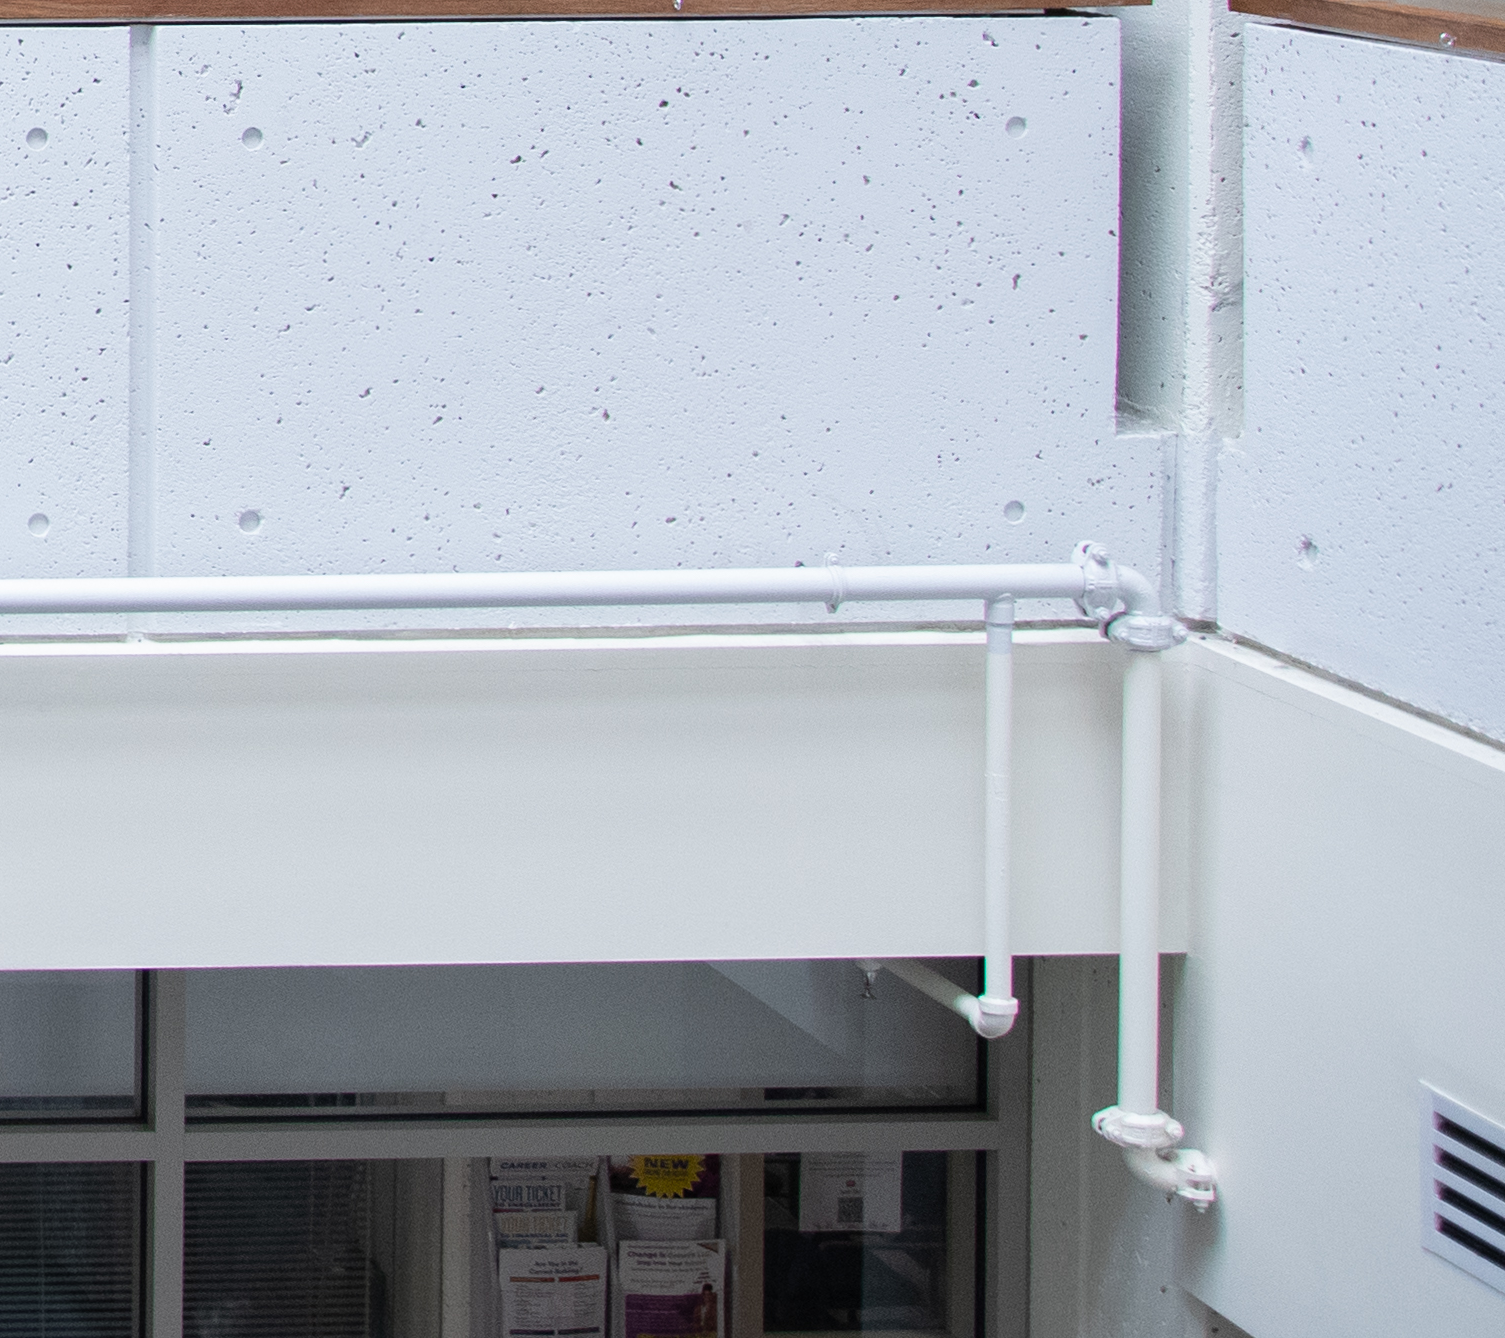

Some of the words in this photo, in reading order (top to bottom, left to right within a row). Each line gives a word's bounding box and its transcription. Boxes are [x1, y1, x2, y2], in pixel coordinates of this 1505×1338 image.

[645, 1157, 689, 1169] NEW
[494, 1185, 523, 1202] YOUR
[526, 1185, 562, 1202] TICKET
